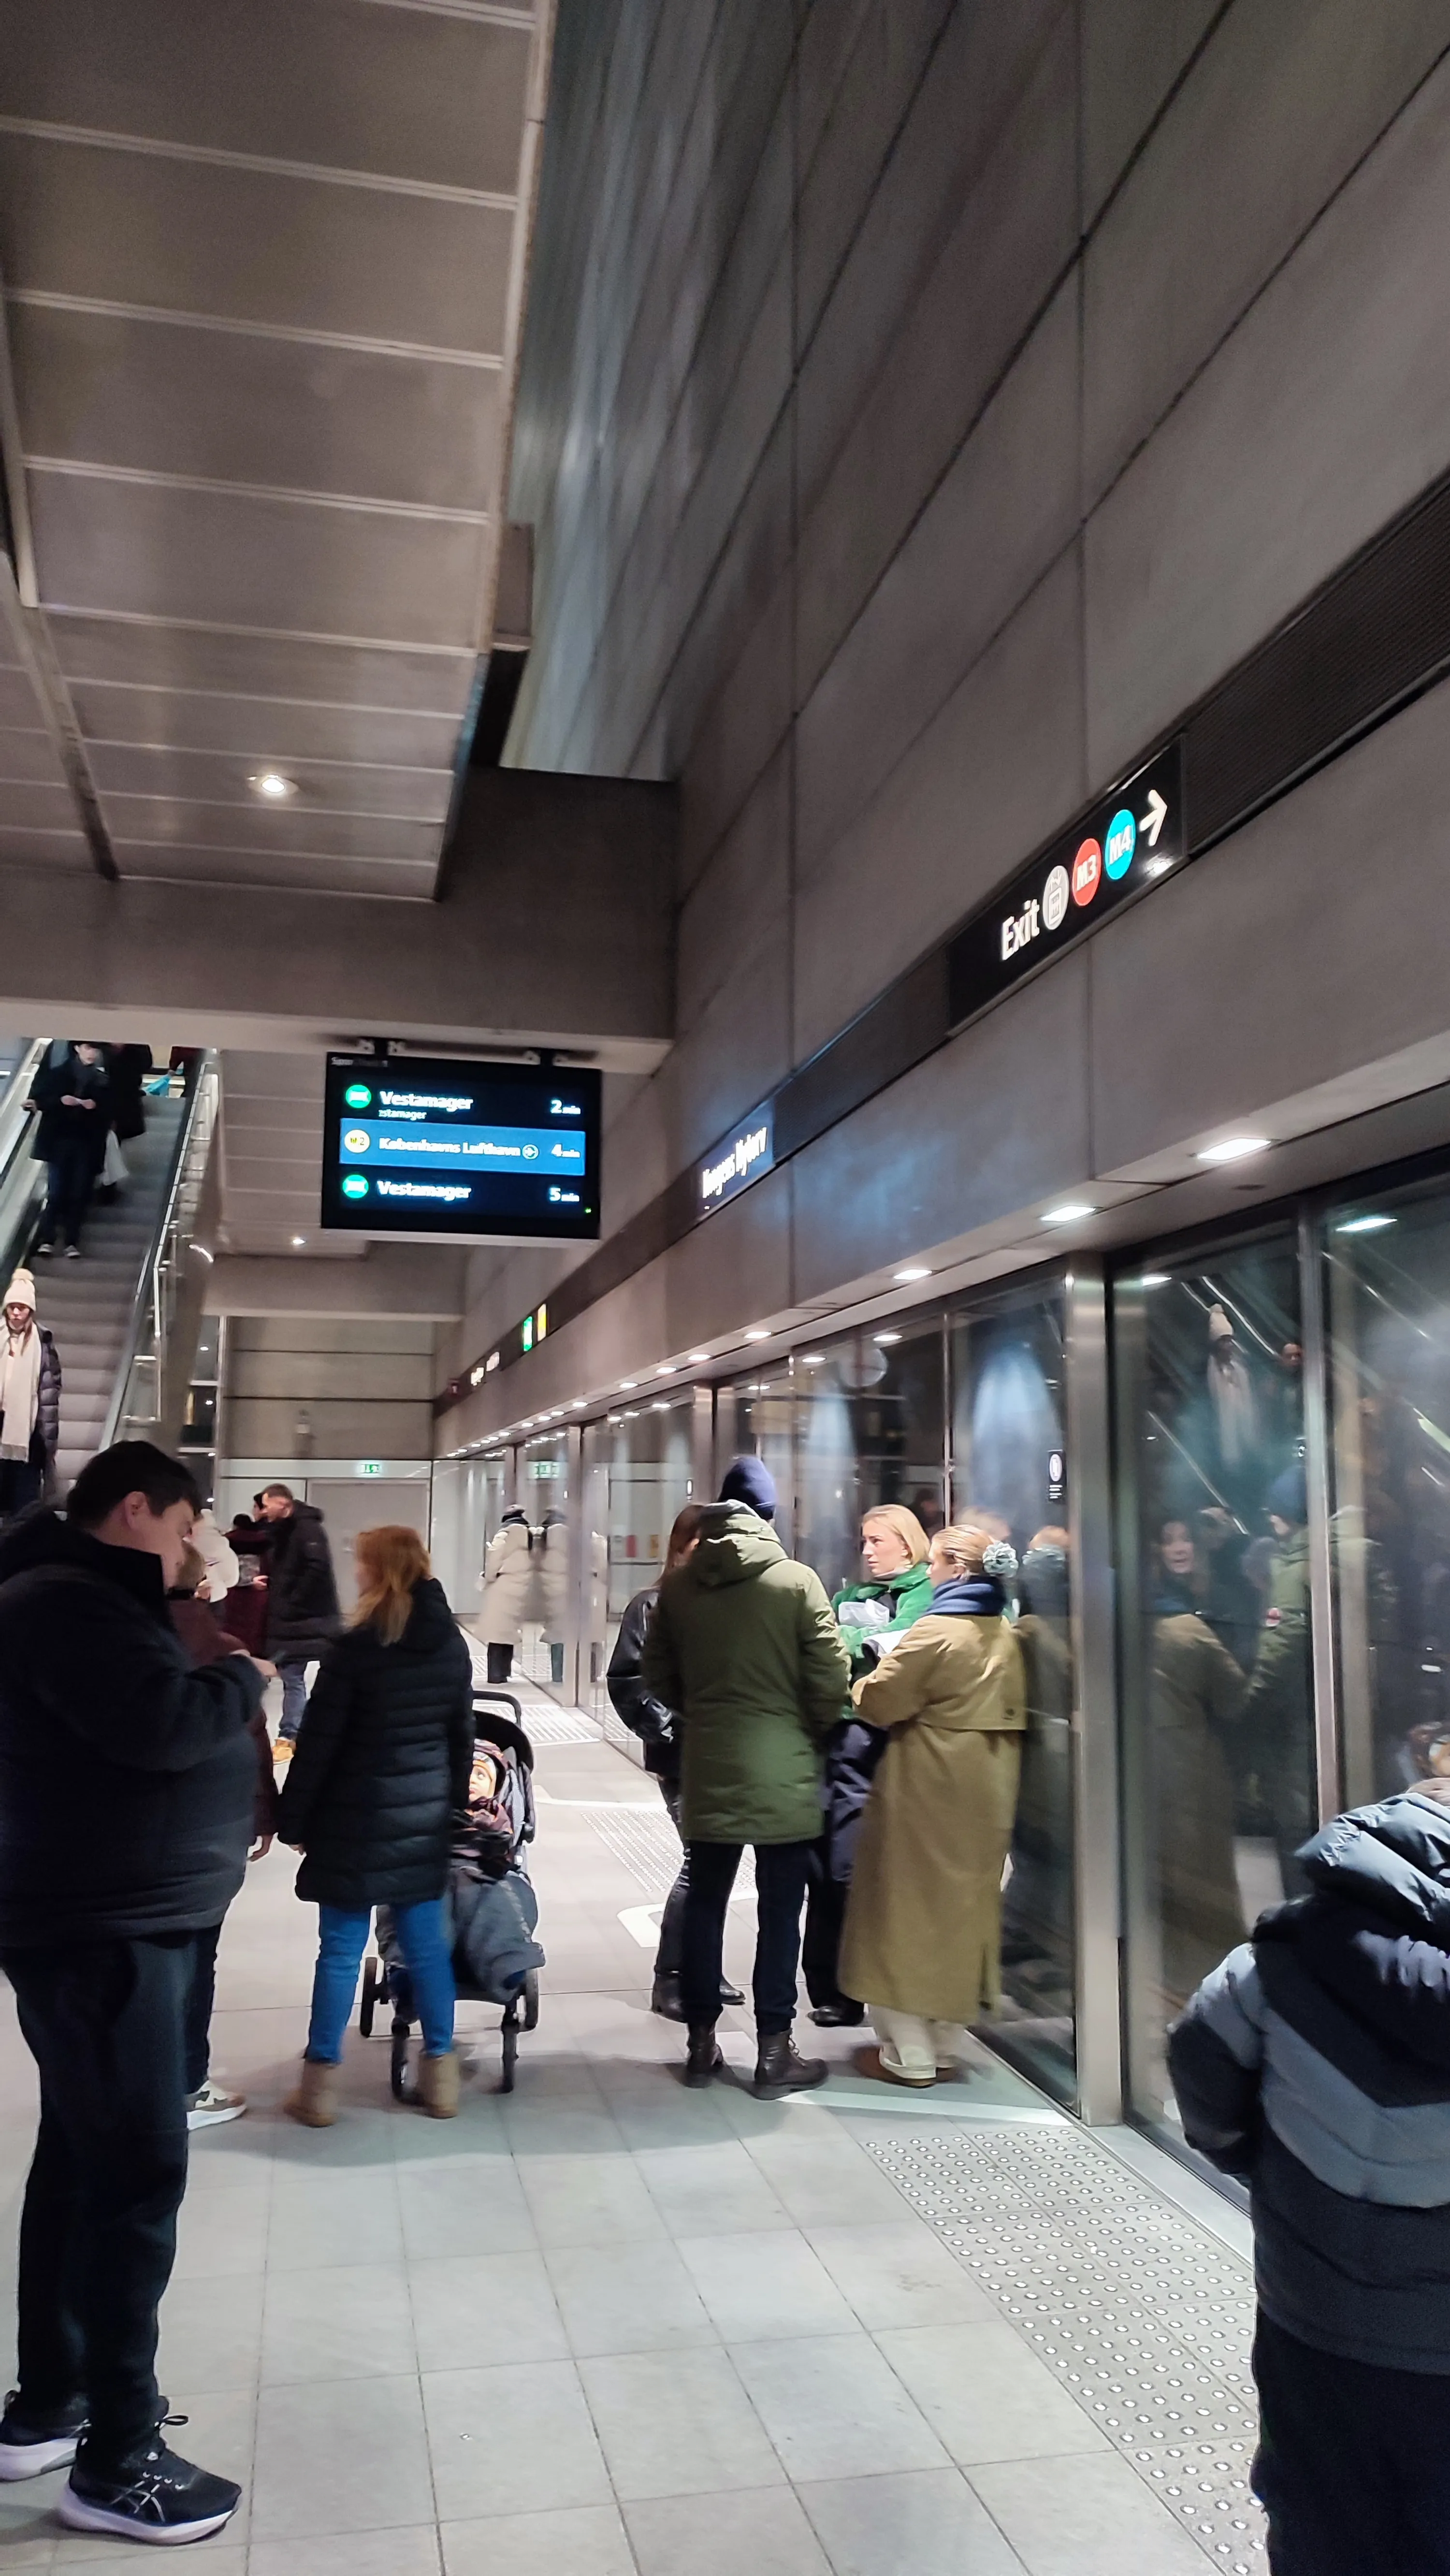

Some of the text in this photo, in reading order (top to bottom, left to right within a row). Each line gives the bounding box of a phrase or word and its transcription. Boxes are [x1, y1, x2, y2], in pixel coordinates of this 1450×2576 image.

[1001, 825, 1132, 961] Exit M3 M4
[380, 1091, 473, 1112] Vestamager
[551, 1100, 562, 1114] 2
[551, 1144, 562, 1157] 4
[377, 1181, 471, 1201] Vestamager
[550, 1187, 561, 1201] 5
